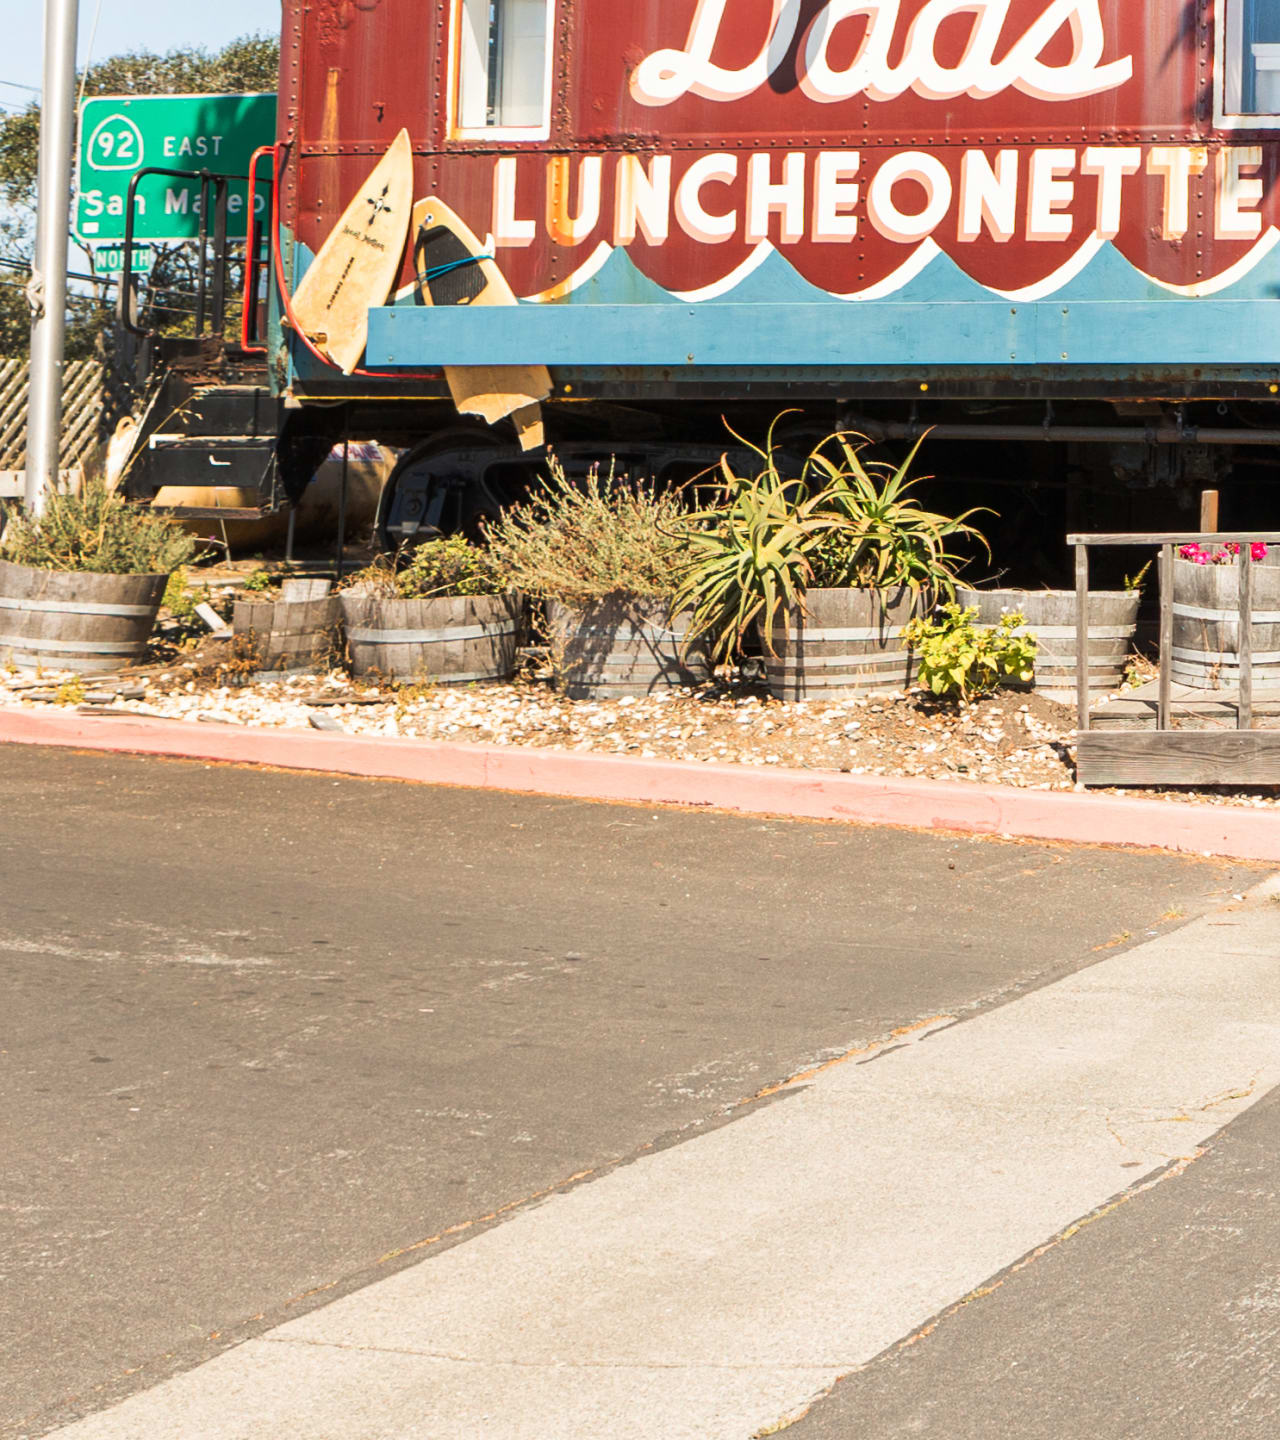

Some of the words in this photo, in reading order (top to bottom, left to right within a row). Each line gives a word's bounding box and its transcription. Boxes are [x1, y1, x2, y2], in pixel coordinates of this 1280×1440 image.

[98, 132, 134, 158] 92
[163, 135, 224, 157] EAST
[84, 189, 146, 217] San
[164, 188, 266, 216] Maeo
[494, 146, 1264, 248] LUNCHEONETTE
